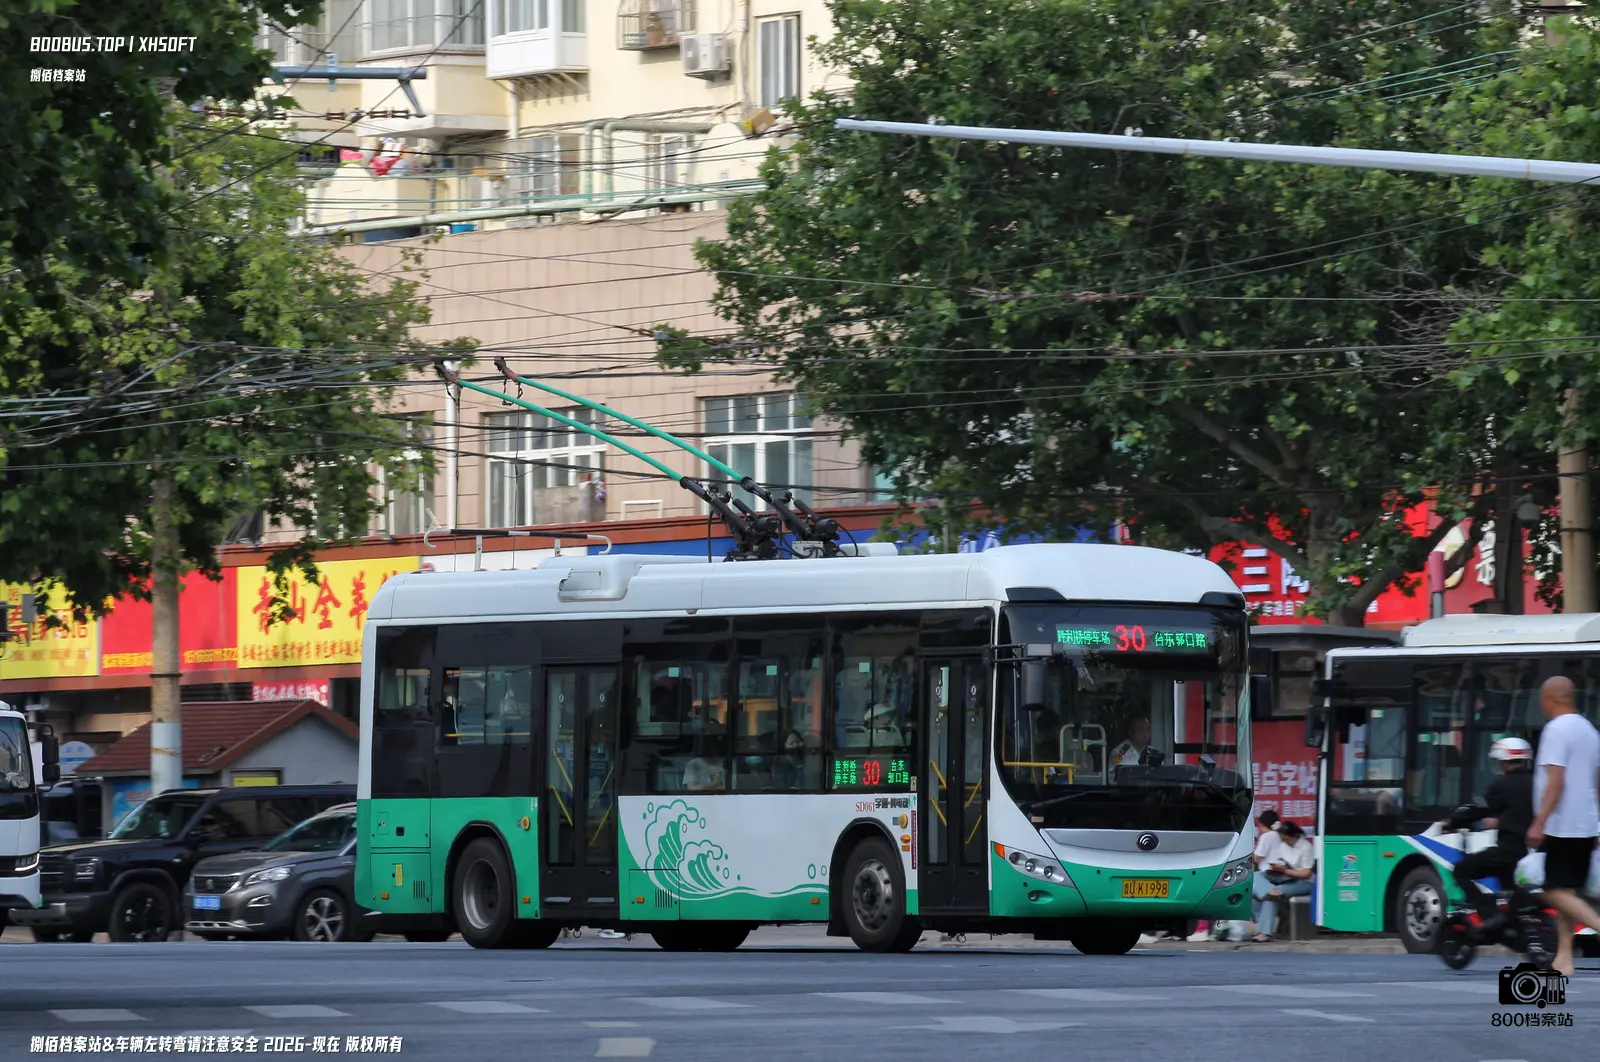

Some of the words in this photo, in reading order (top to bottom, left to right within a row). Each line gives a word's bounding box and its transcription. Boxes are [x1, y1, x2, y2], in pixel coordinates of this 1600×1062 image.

[1115, 625, 1146, 651] 30
[862, 760, 881, 785] 30
[855, 801, 875, 812] SD061
